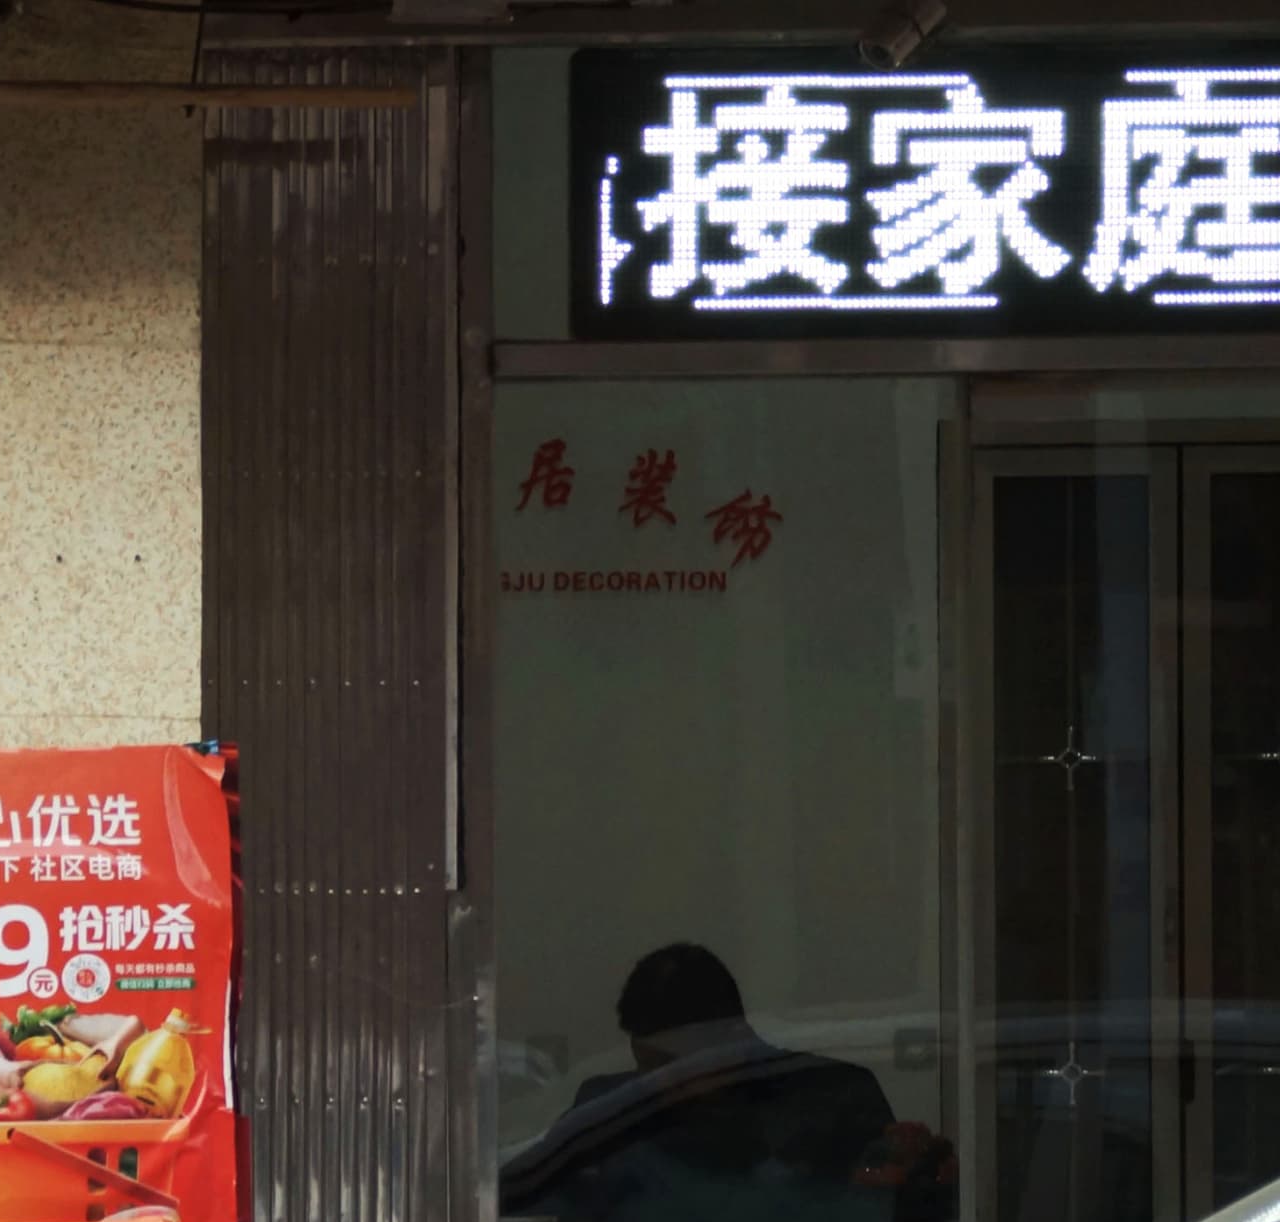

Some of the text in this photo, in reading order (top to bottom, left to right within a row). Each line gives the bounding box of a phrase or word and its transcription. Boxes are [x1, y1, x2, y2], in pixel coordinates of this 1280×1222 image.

[600, 82, 1280, 297] 接家庭
[554, 572, 727, 592] DECORATION
[30, 853, 143, 882] 社区电商
[59, 904, 196, 952] 抢秒杀
